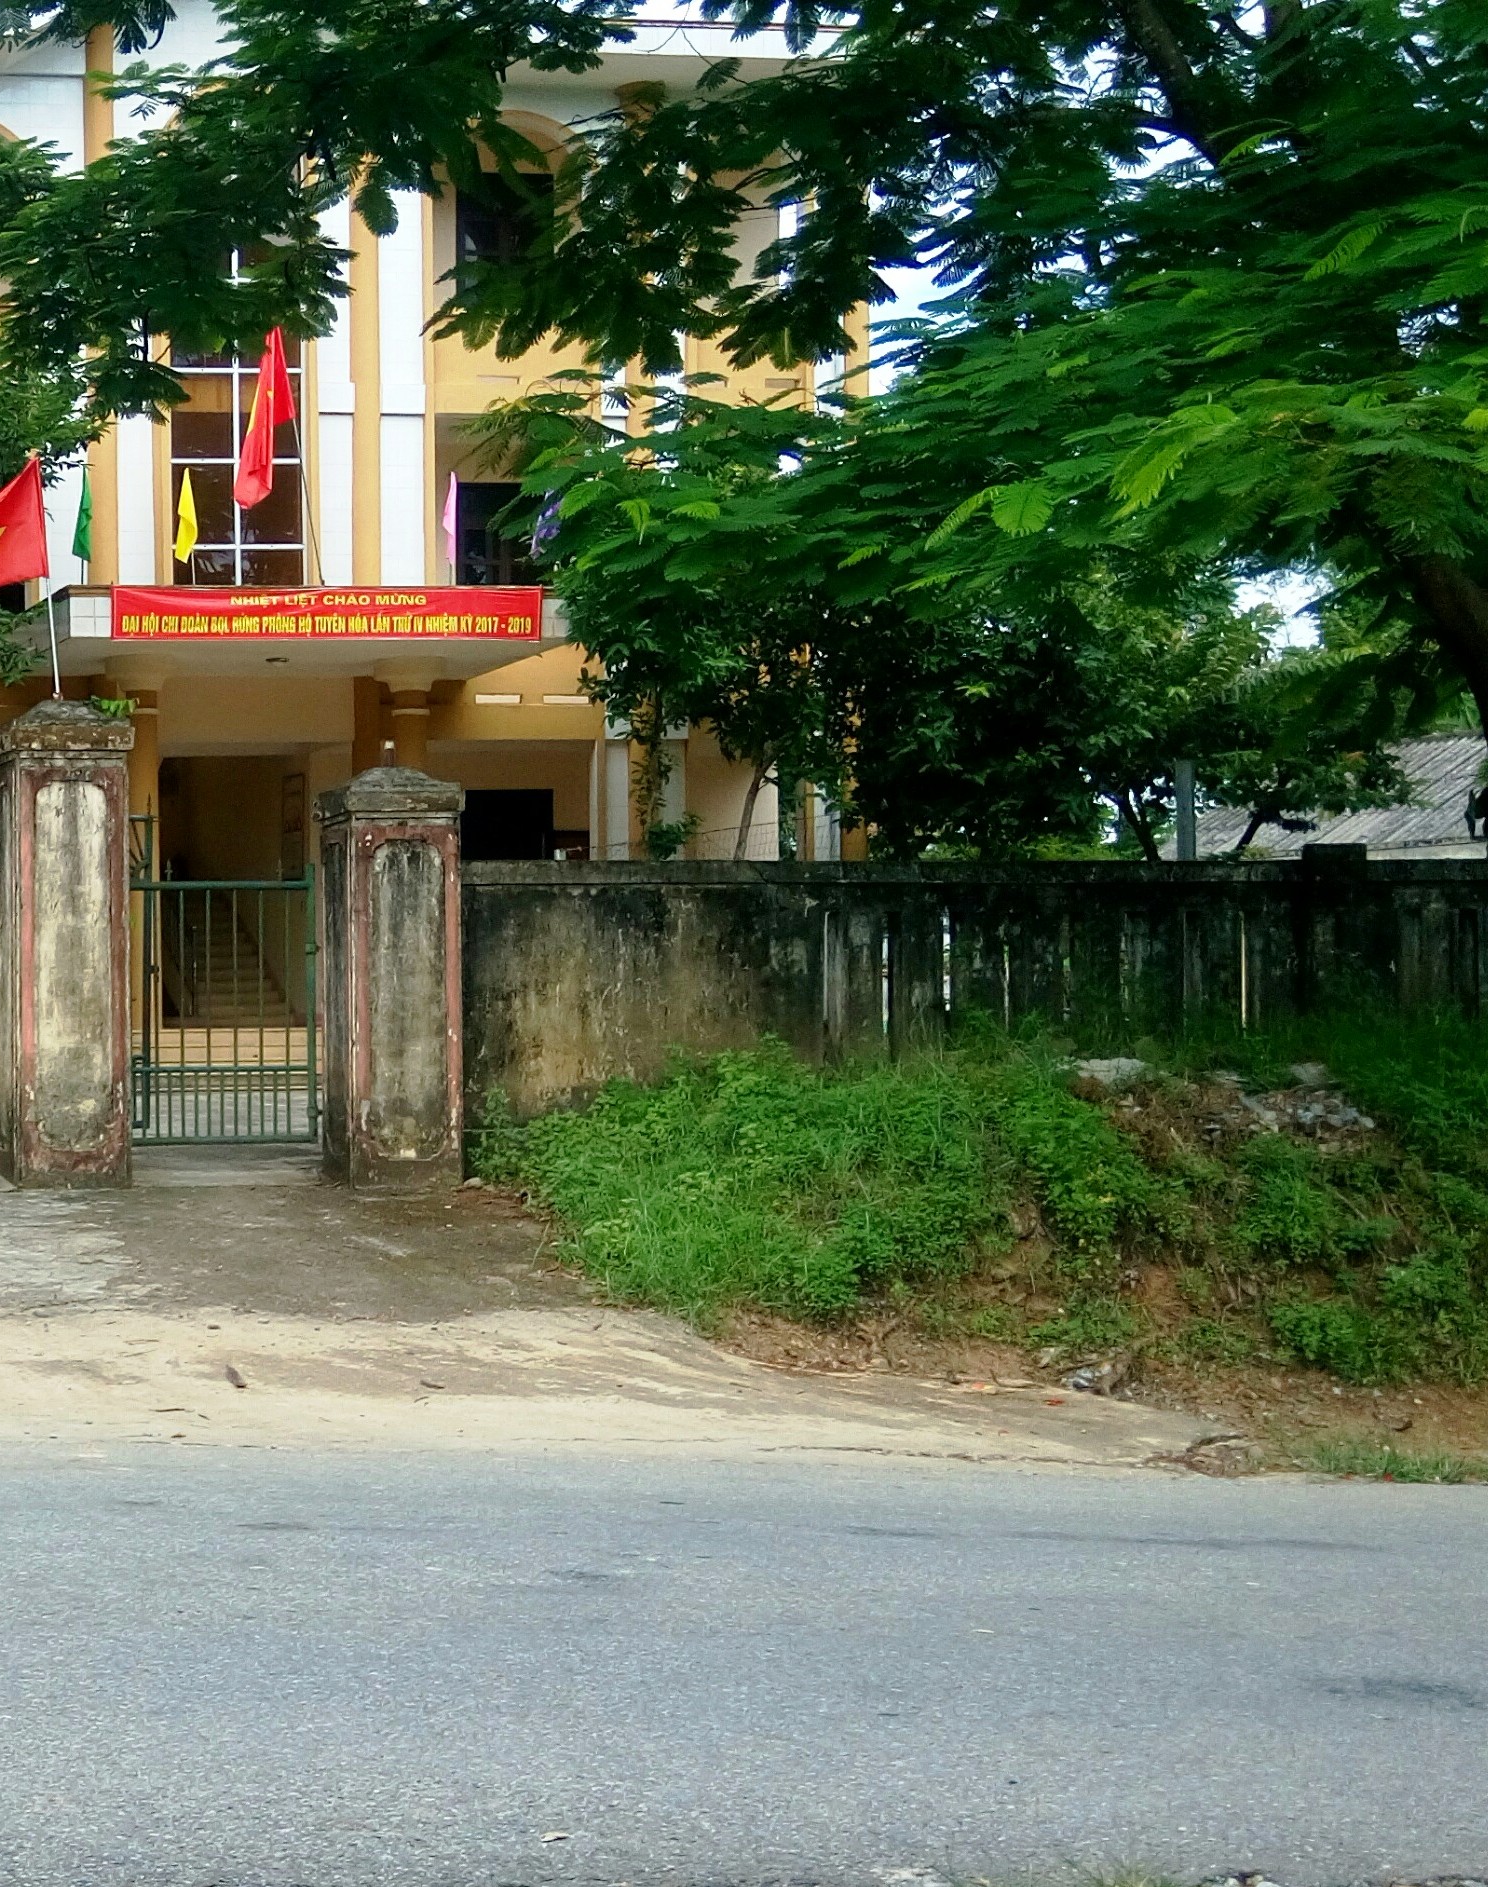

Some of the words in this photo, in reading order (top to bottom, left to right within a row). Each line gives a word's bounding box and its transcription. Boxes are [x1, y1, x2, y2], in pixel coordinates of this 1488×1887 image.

[230, 594, 279, 608] NHIỆT
[284, 593, 318, 608] LIỆT
[142, 612, 159, 636] HỘI
[162, 616, 179, 633] CHI
[475, 616, 499, 633] 2017
[508, 616, 531, 633] 2019
